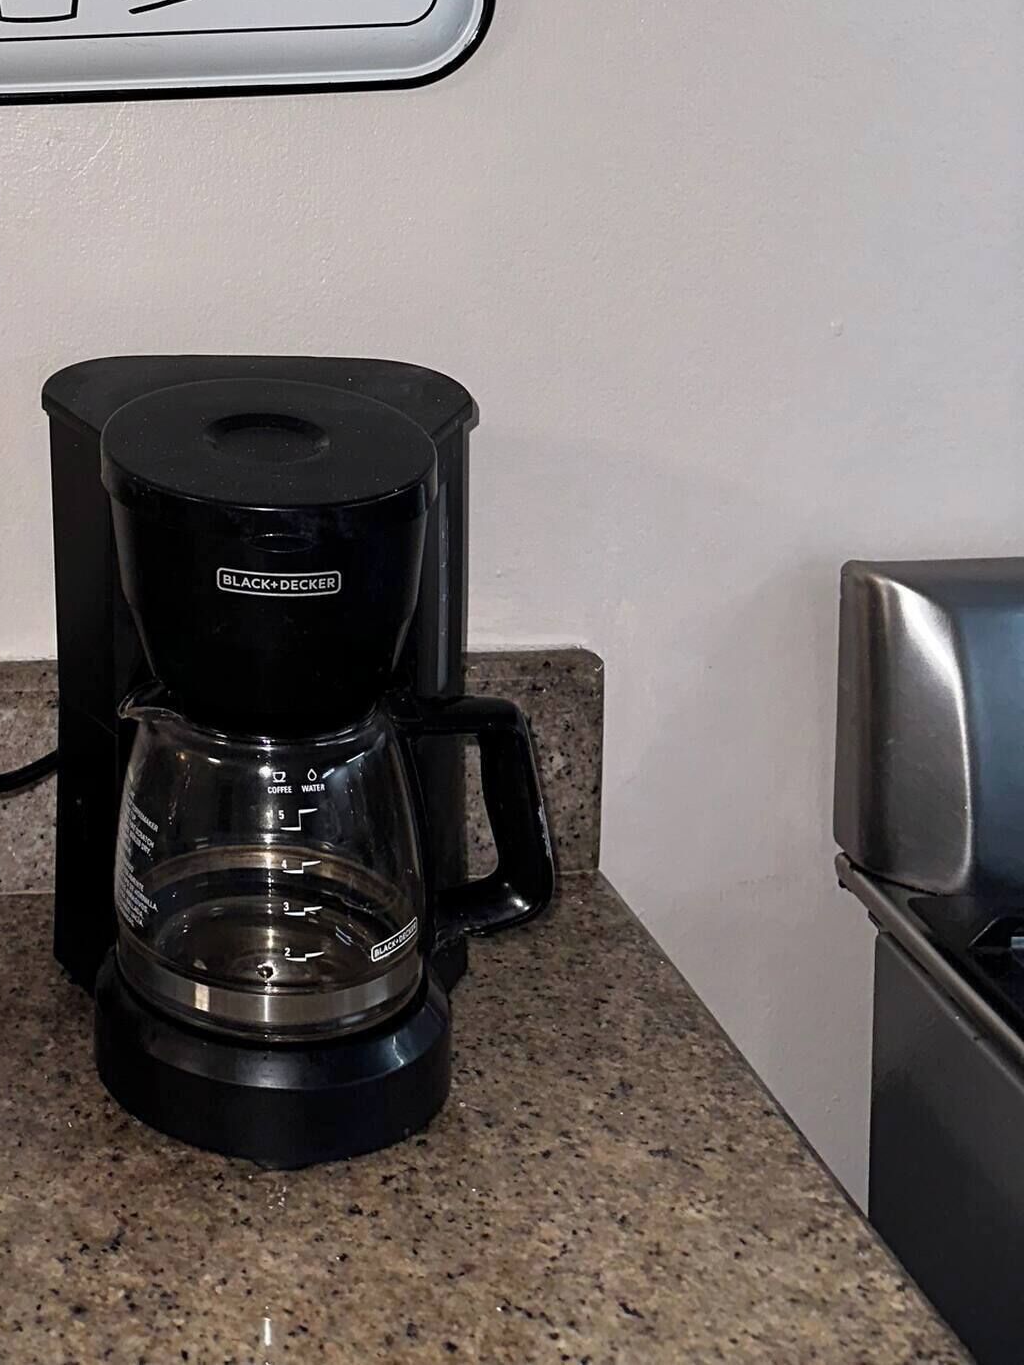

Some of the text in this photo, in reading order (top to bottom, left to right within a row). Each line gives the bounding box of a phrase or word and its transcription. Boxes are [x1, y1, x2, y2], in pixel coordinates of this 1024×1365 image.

[223, 574, 336, 590] BLACK+DECKER
[267, 785, 293, 794] COFFEE
[301, 784, 326, 793] WATER
[278, 810, 285, 820] 5
[281, 859, 287, 869] 4
[283, 902, 289, 911] 3
[284, 947, 291, 957] 2
